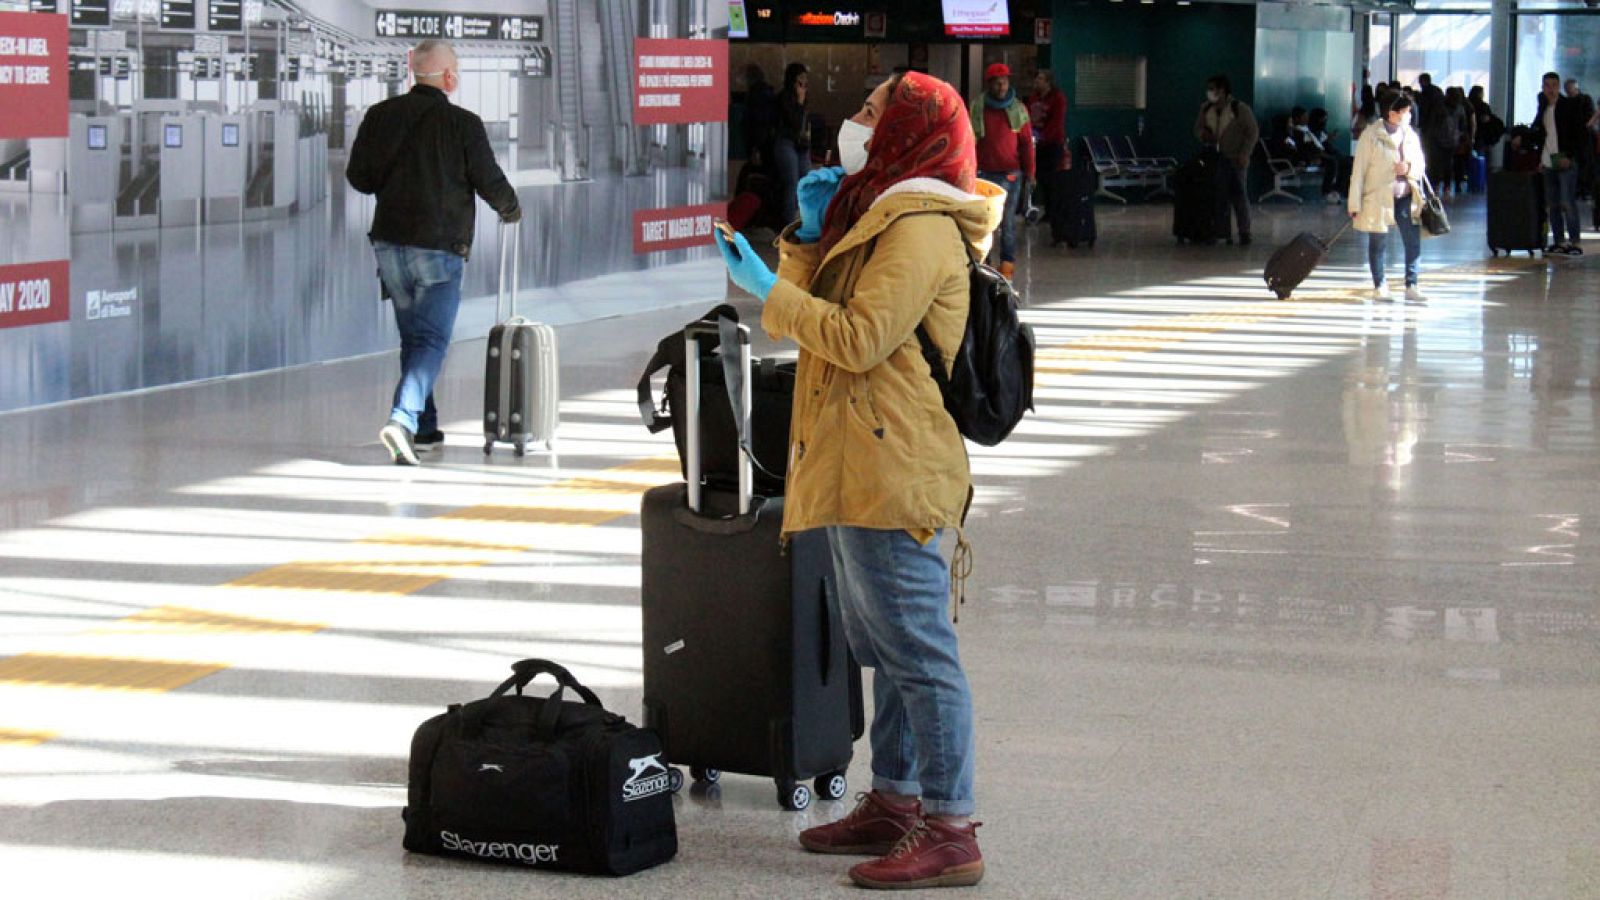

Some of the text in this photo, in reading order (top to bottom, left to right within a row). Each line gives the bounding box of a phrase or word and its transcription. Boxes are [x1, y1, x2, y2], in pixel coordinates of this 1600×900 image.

[26, 65, 50, 85] SERVE
[642, 214, 712, 242] TARGET MAGGIO 2020
[18, 278, 50, 311] 2020
[623, 774, 669, 798] Slazenge
[440, 830, 560, 864] Slazenger
